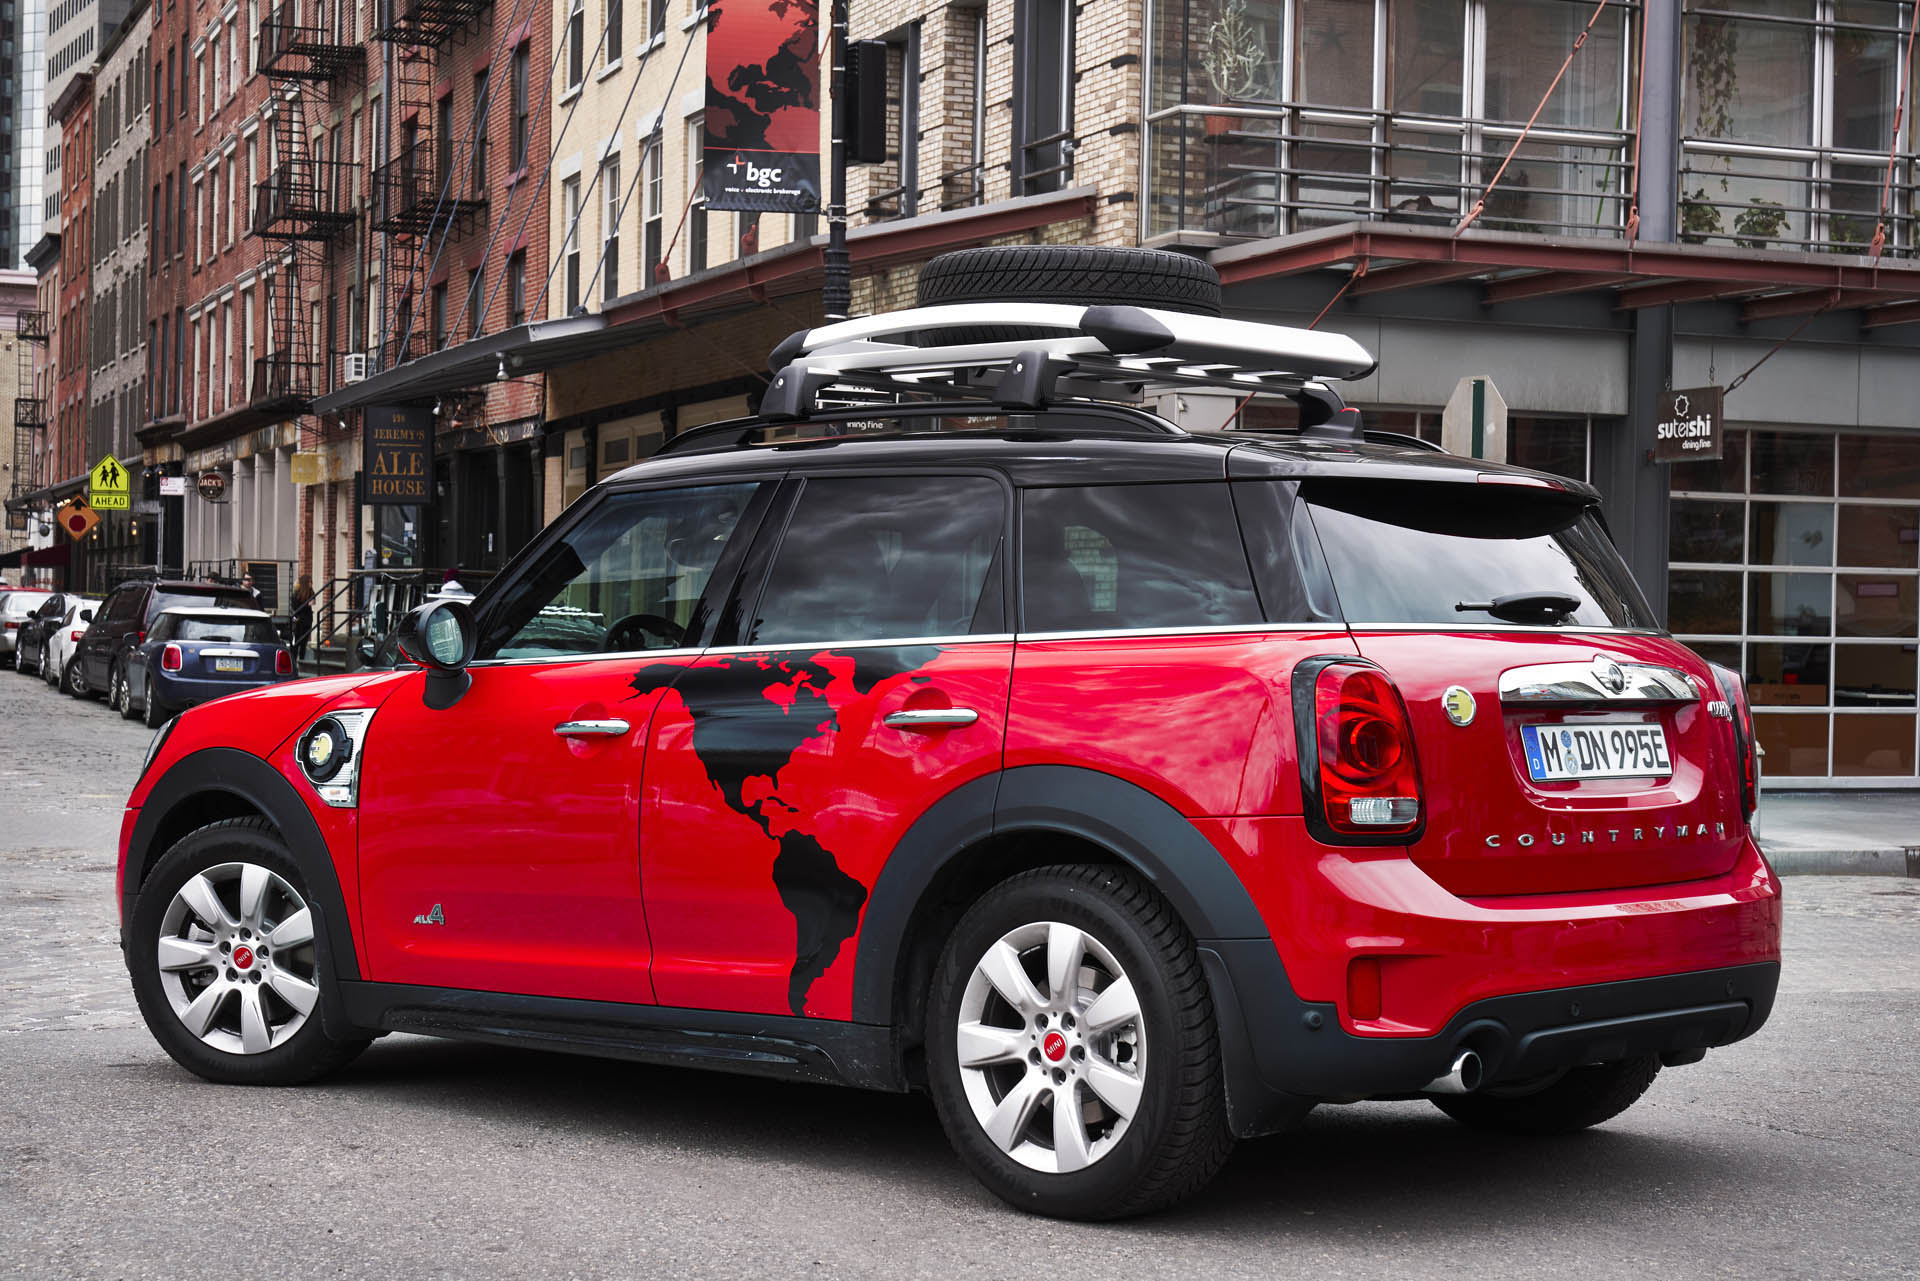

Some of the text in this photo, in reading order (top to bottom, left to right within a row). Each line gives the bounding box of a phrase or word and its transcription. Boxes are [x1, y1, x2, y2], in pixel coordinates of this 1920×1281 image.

[746, 162, 782, 187] bgc
[773, 188, 800, 196] brokerage
[375, 429, 425, 441] JEREMY'S
[1657, 414, 1711, 439] suteishi
[371, 450, 425, 475] ALE
[199, 478, 222, 487] JACK'S
[372, 480, 425, 496] HOUSE
[95, 497, 125, 506] AHEAD
[1533, 730, 1670, 772] D M DN 995E
[1486, 822, 1725, 848] COUNTRYMAN
[1046, 1038, 1063, 1056] MINI
